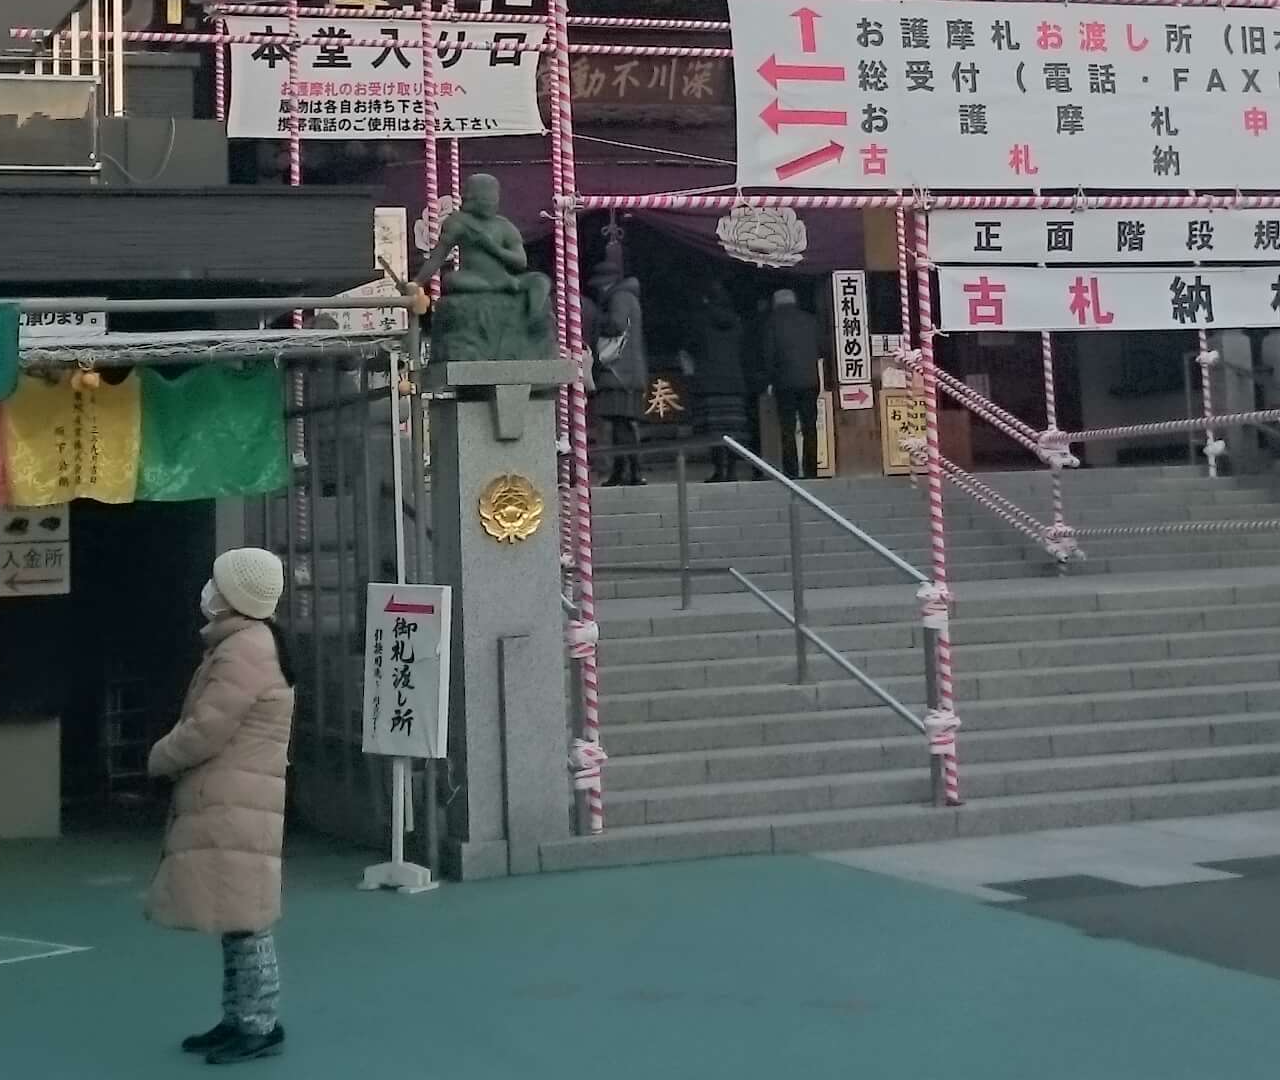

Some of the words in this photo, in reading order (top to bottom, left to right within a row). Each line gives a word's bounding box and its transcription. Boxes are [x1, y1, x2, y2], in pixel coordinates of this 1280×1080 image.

[249, 24, 528, 69] 本堂入り口
[841, 277, 864, 378] 古札納め所
[2, 548, 64, 568] 入金所
[390, 616, 418, 736] 御札渡し所
